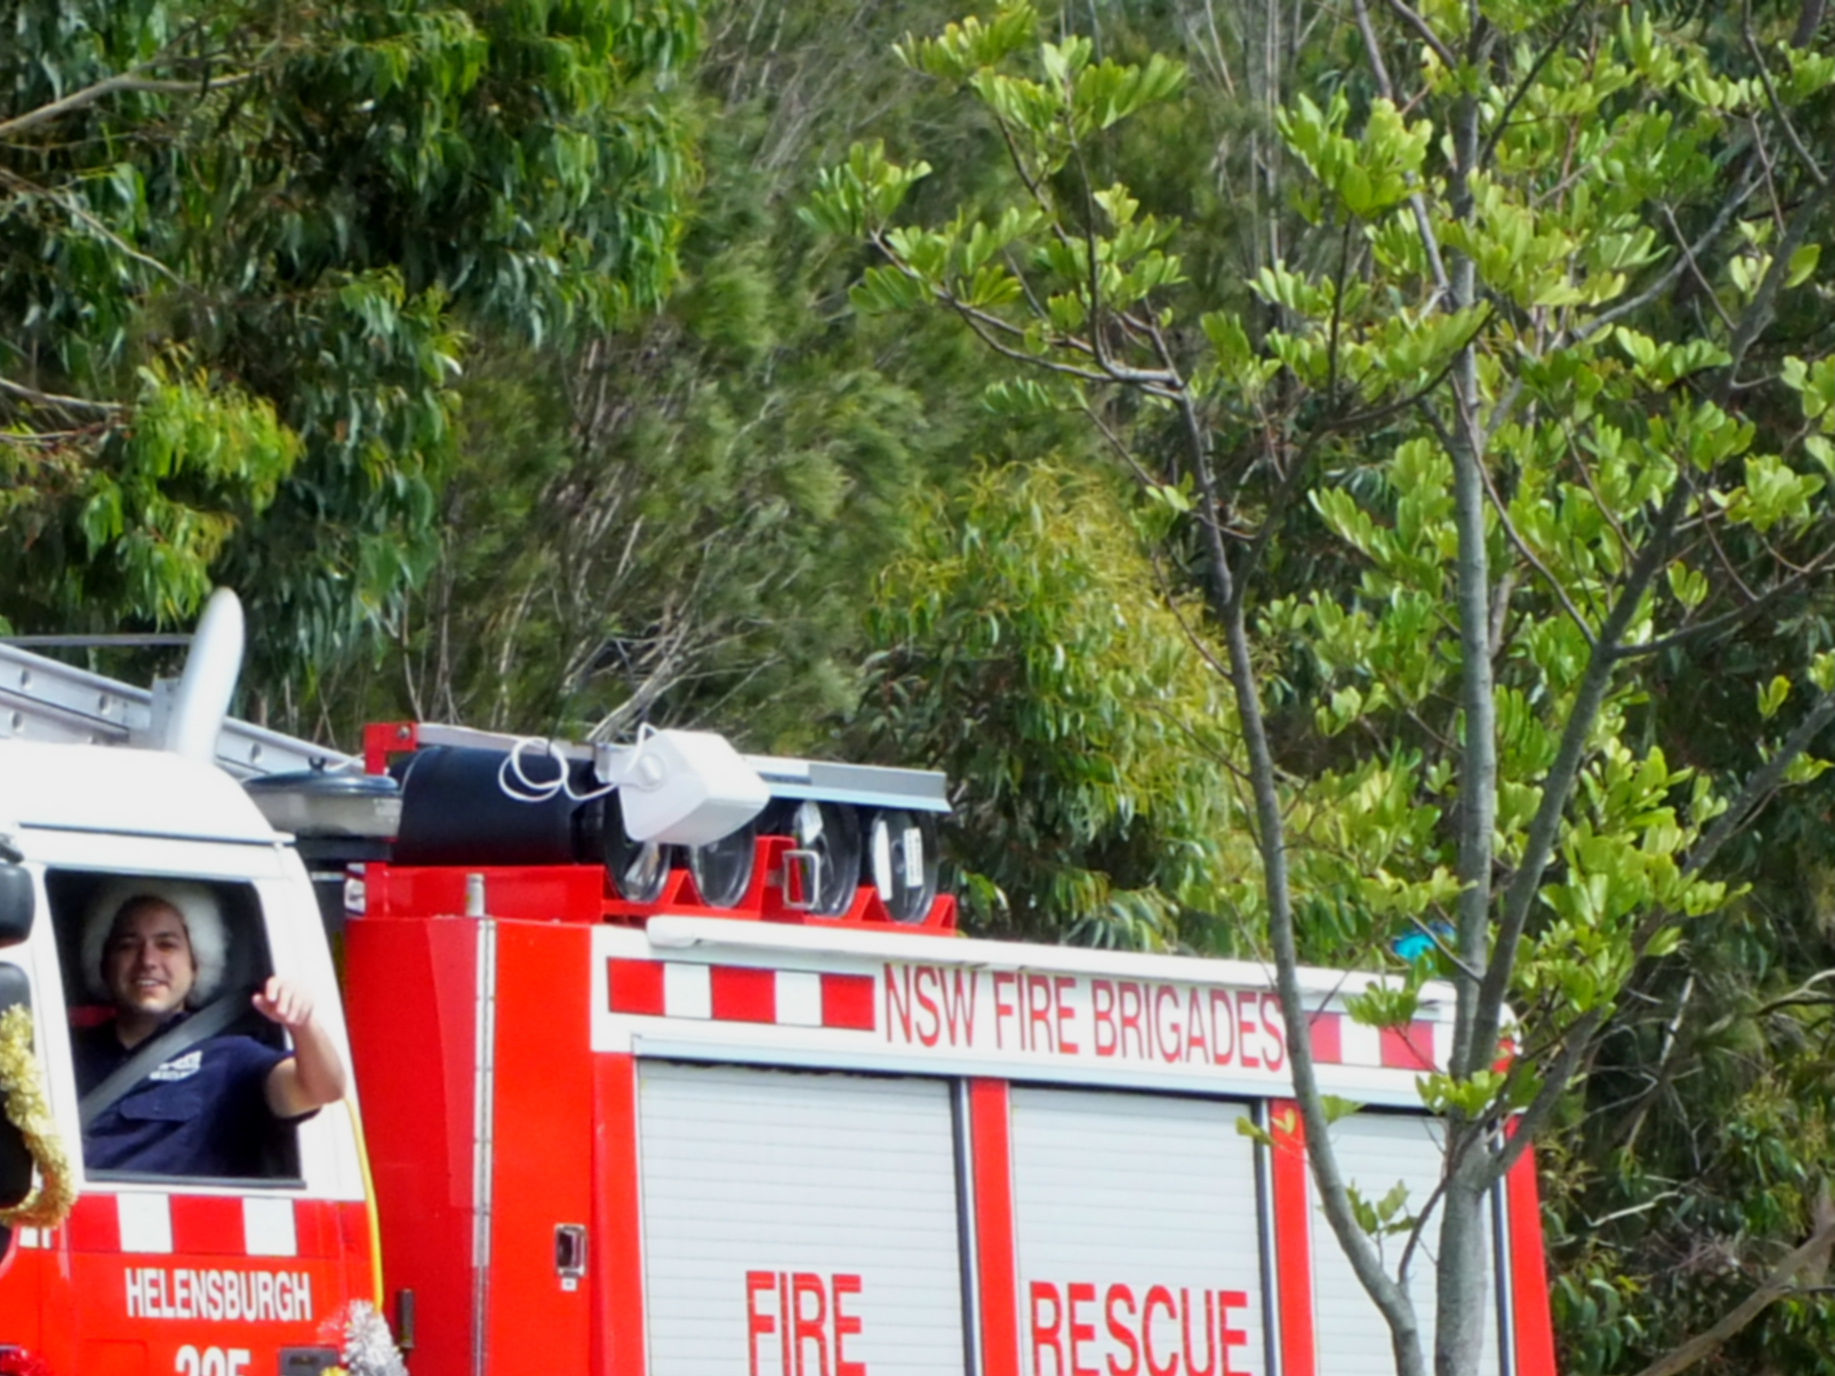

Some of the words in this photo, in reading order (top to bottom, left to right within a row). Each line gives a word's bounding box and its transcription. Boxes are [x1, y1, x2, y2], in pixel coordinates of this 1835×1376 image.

[883, 962, 978, 1048] NSW
[992, 970, 1079, 1055] FIRE
[1090, 979, 1286, 1073] BRIGADES
[124, 1267, 313, 1322] HELENSBURGH
